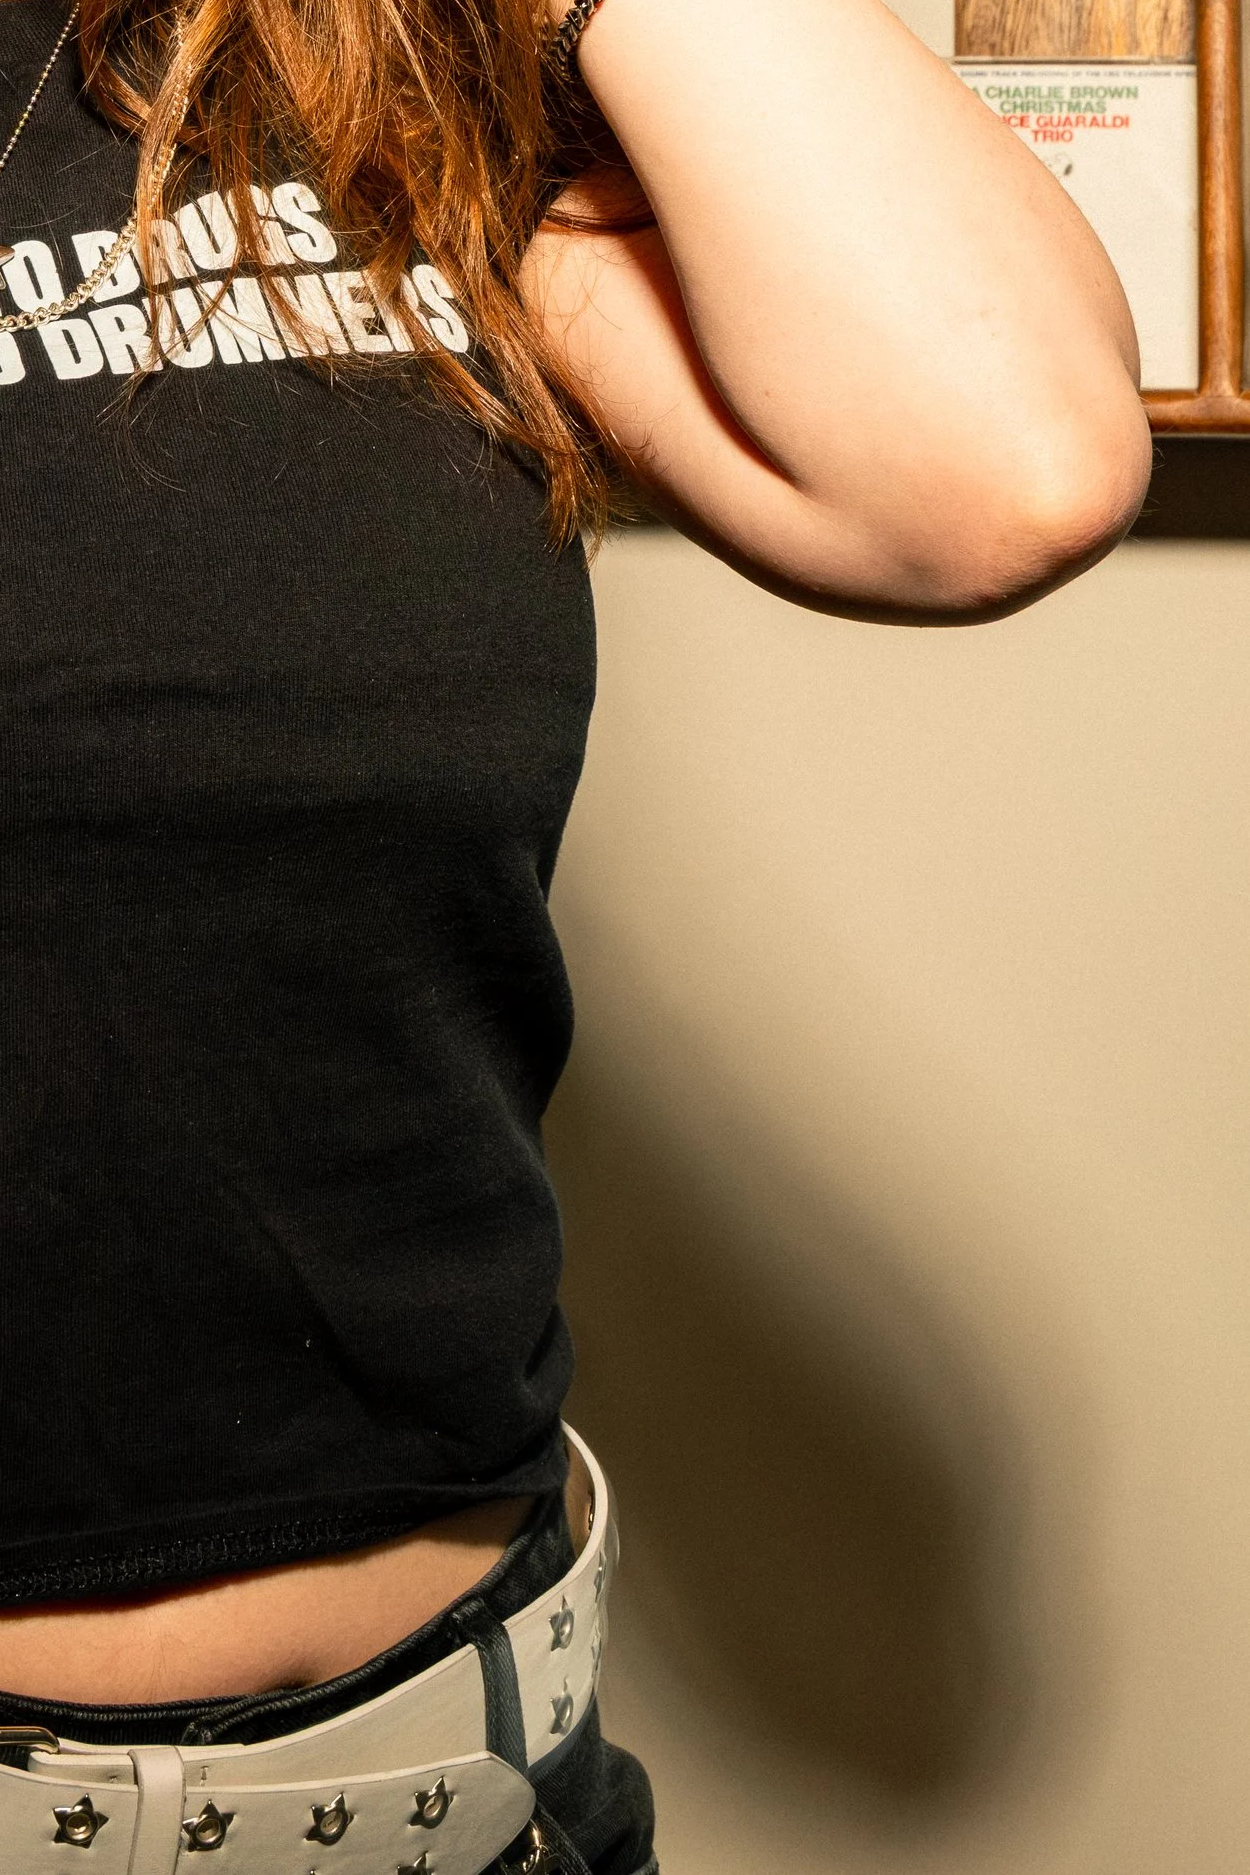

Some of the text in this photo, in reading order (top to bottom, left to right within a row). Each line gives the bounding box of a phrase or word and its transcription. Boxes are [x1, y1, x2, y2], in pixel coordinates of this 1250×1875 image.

[986, 85, 1064, 100] CHARLIE
[1070, 85, 1139, 99] BROWN
[1000, 100, 1107, 114] CHRISTMAS
[1036, 115, 1130, 128] GUARALDI
[1031, 129, 1074, 142] TRIO
[71, 181, 338, 303] DRUGS
[38, 264, 470, 381] DRUMMERS
